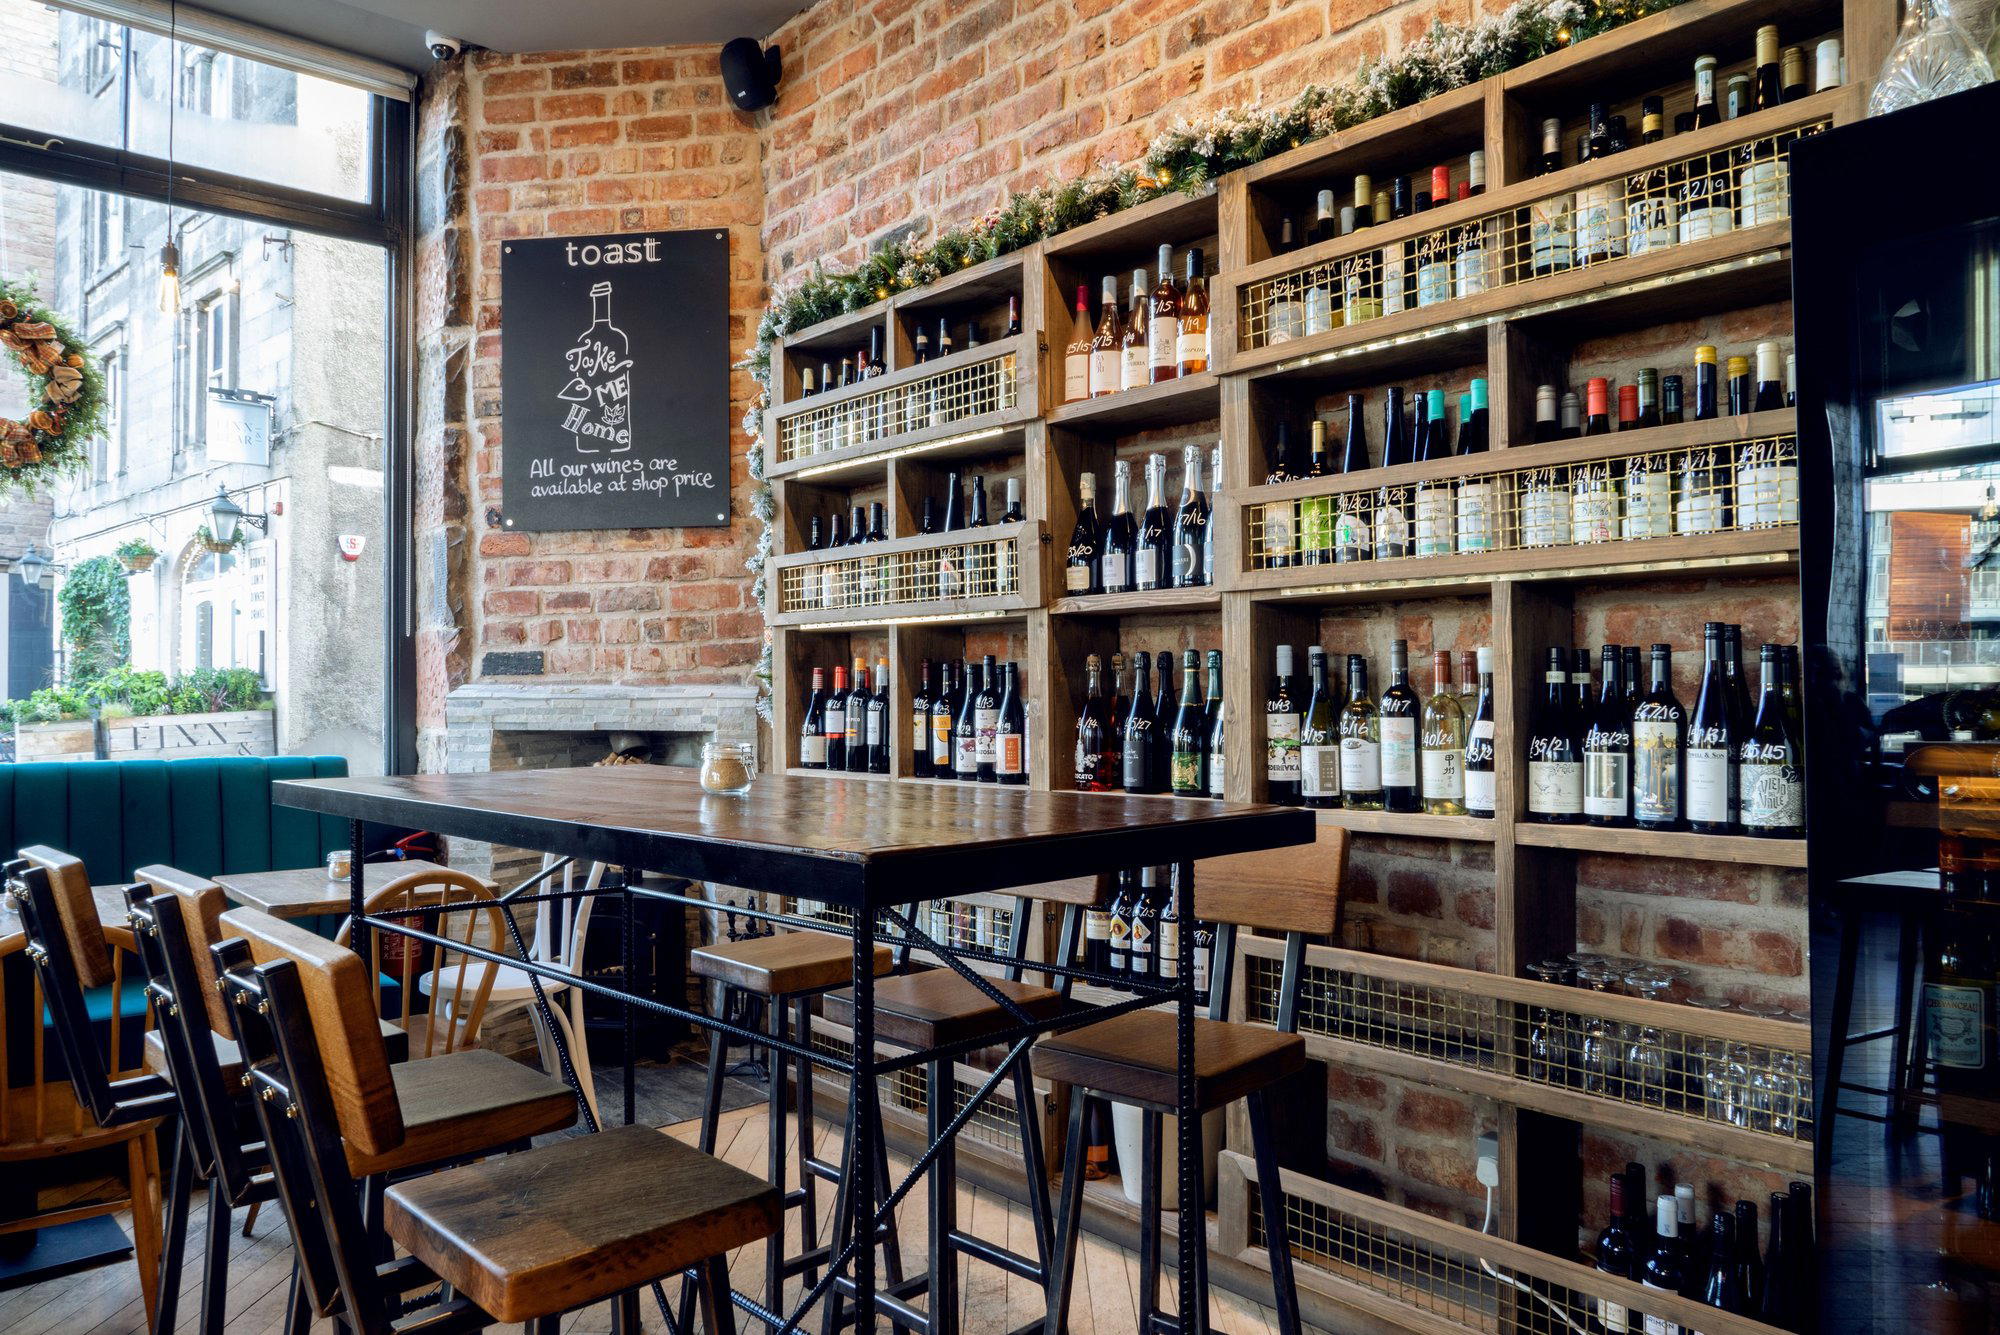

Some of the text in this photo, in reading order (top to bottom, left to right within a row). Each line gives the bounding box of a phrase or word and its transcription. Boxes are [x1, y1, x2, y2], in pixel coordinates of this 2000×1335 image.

[566, 237, 661, 267] toast
[594, 374, 628, 408] ME
[561, 403, 630, 444] Home
[530, 456, 678, 479] All our wines are
[531, 470, 715, 498] available at shop price
